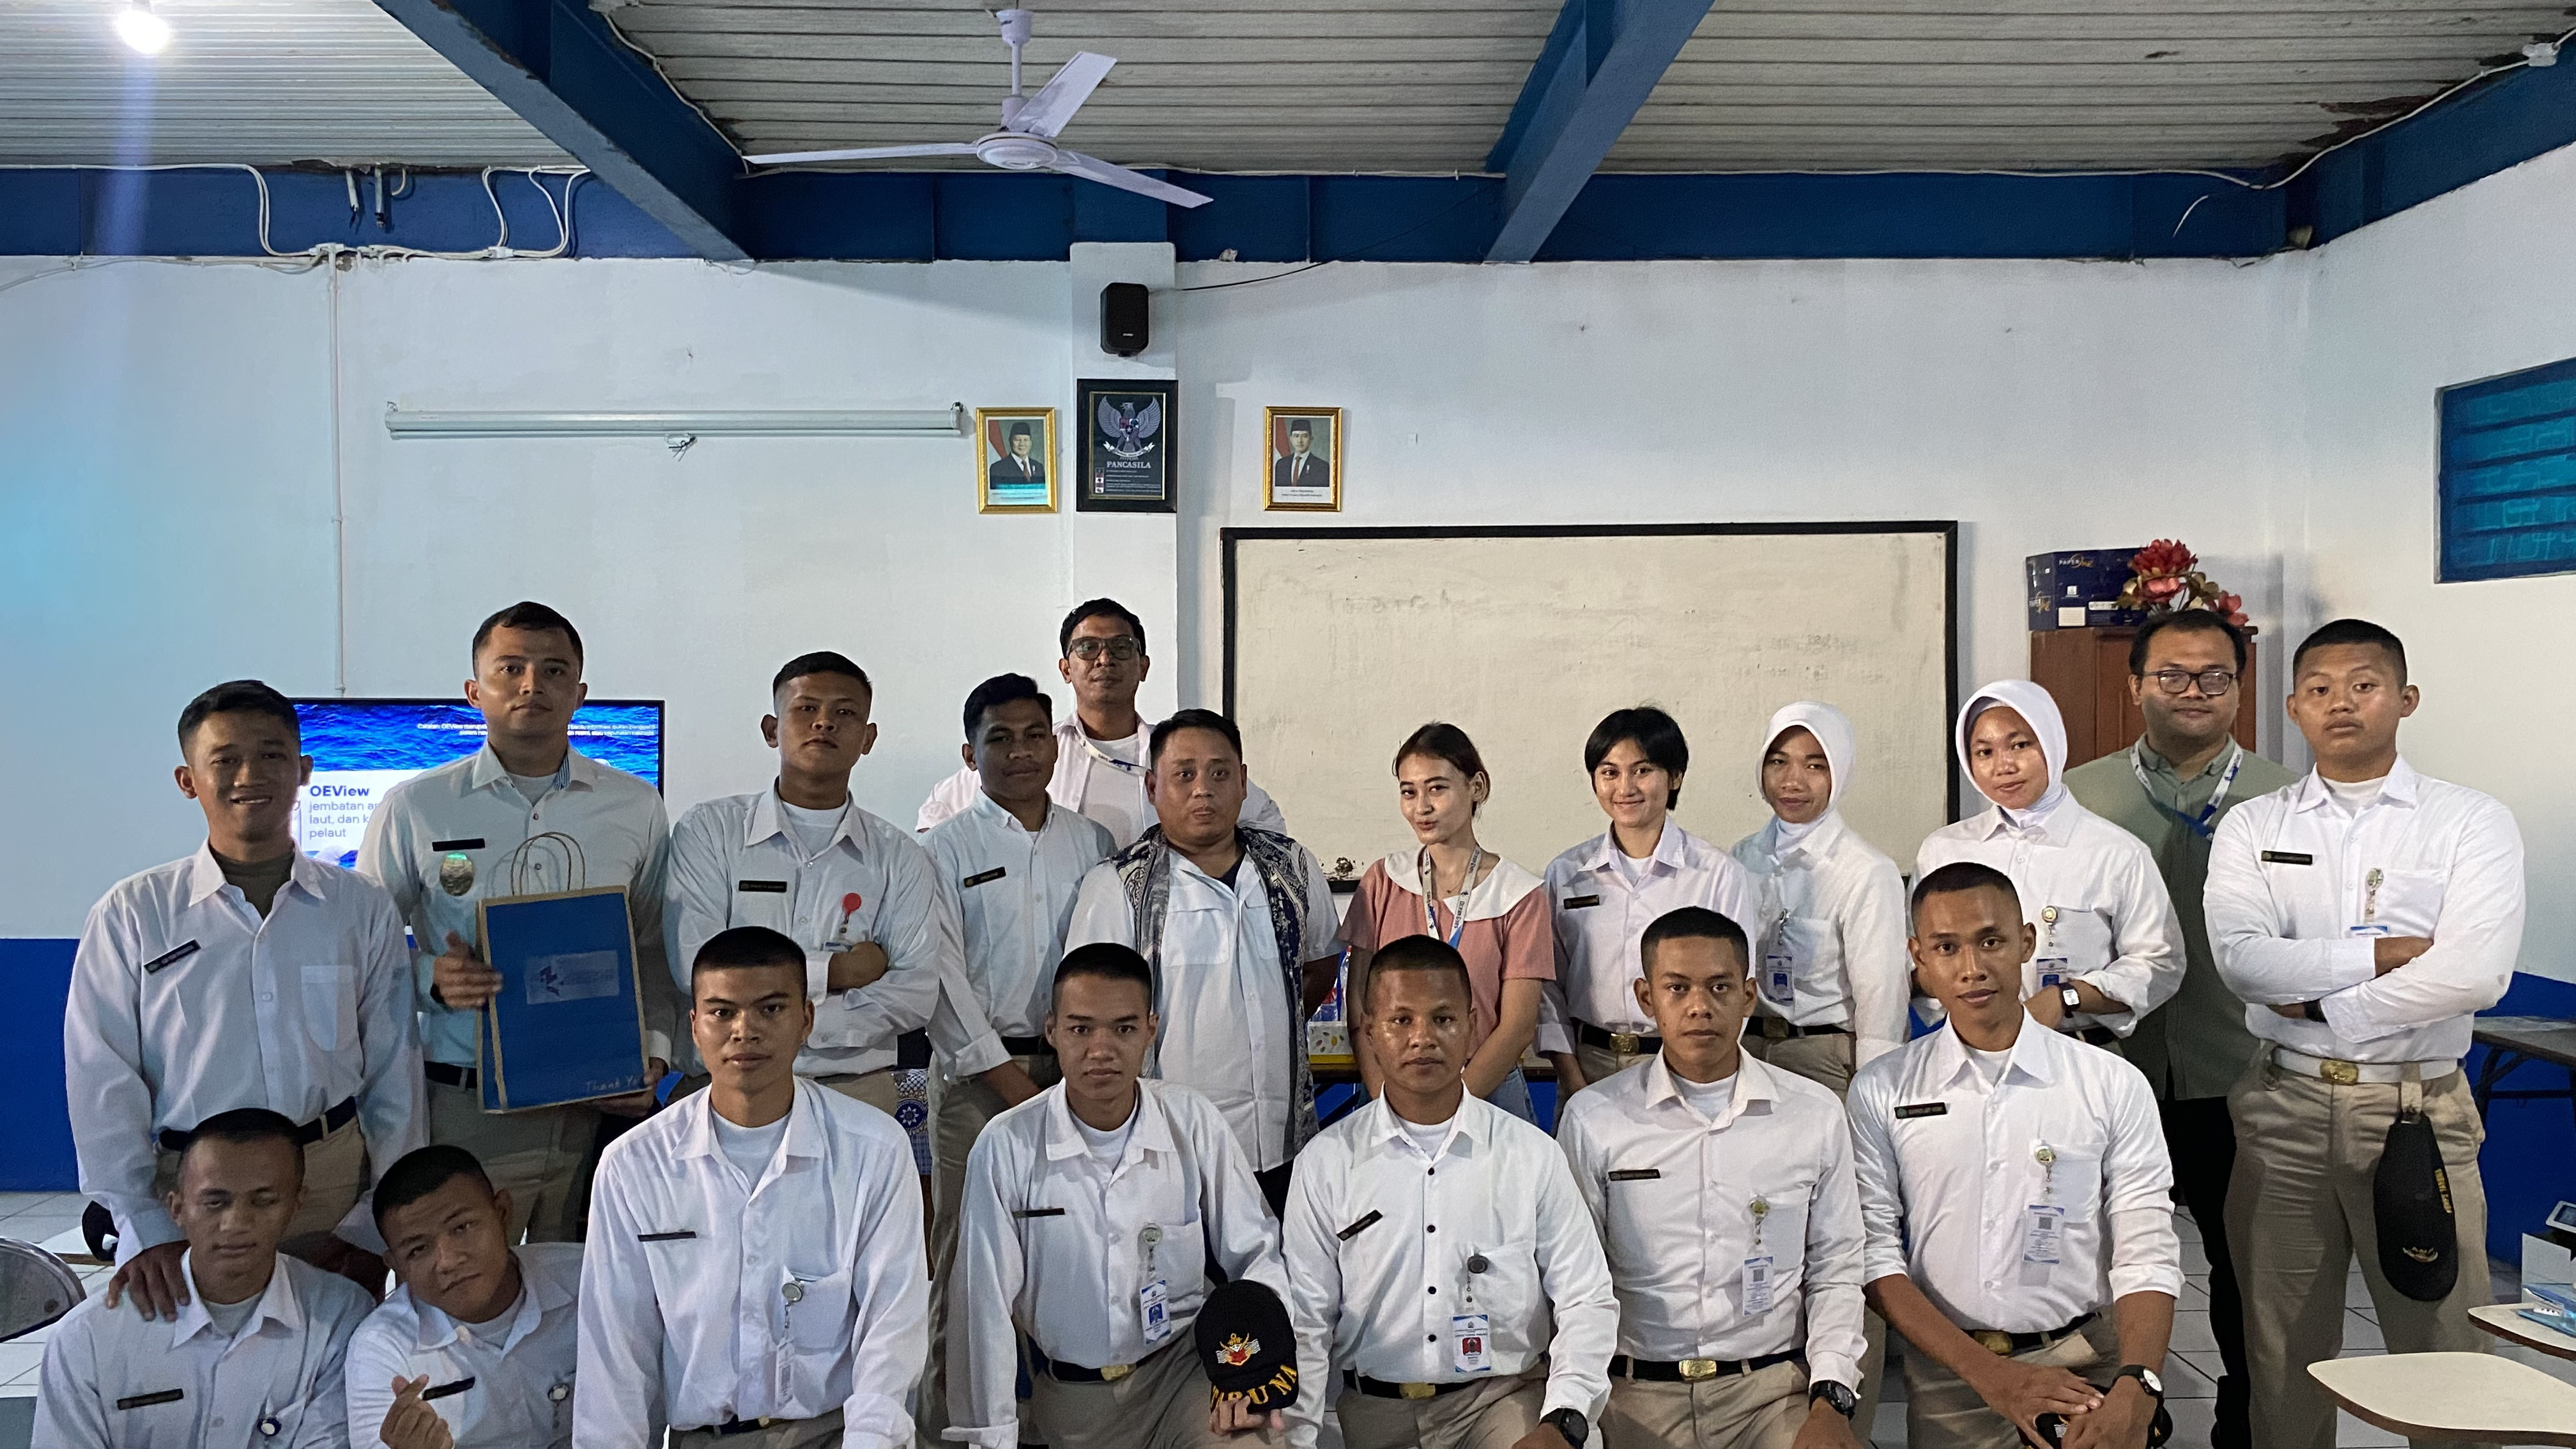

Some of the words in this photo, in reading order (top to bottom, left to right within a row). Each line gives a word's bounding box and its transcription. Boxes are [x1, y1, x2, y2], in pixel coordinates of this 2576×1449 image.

[310, 785, 370, 797] OEView
[309, 801, 364, 813] jembatan
[337, 814, 360, 824] dan
[310, 828, 346, 840] pelaut
